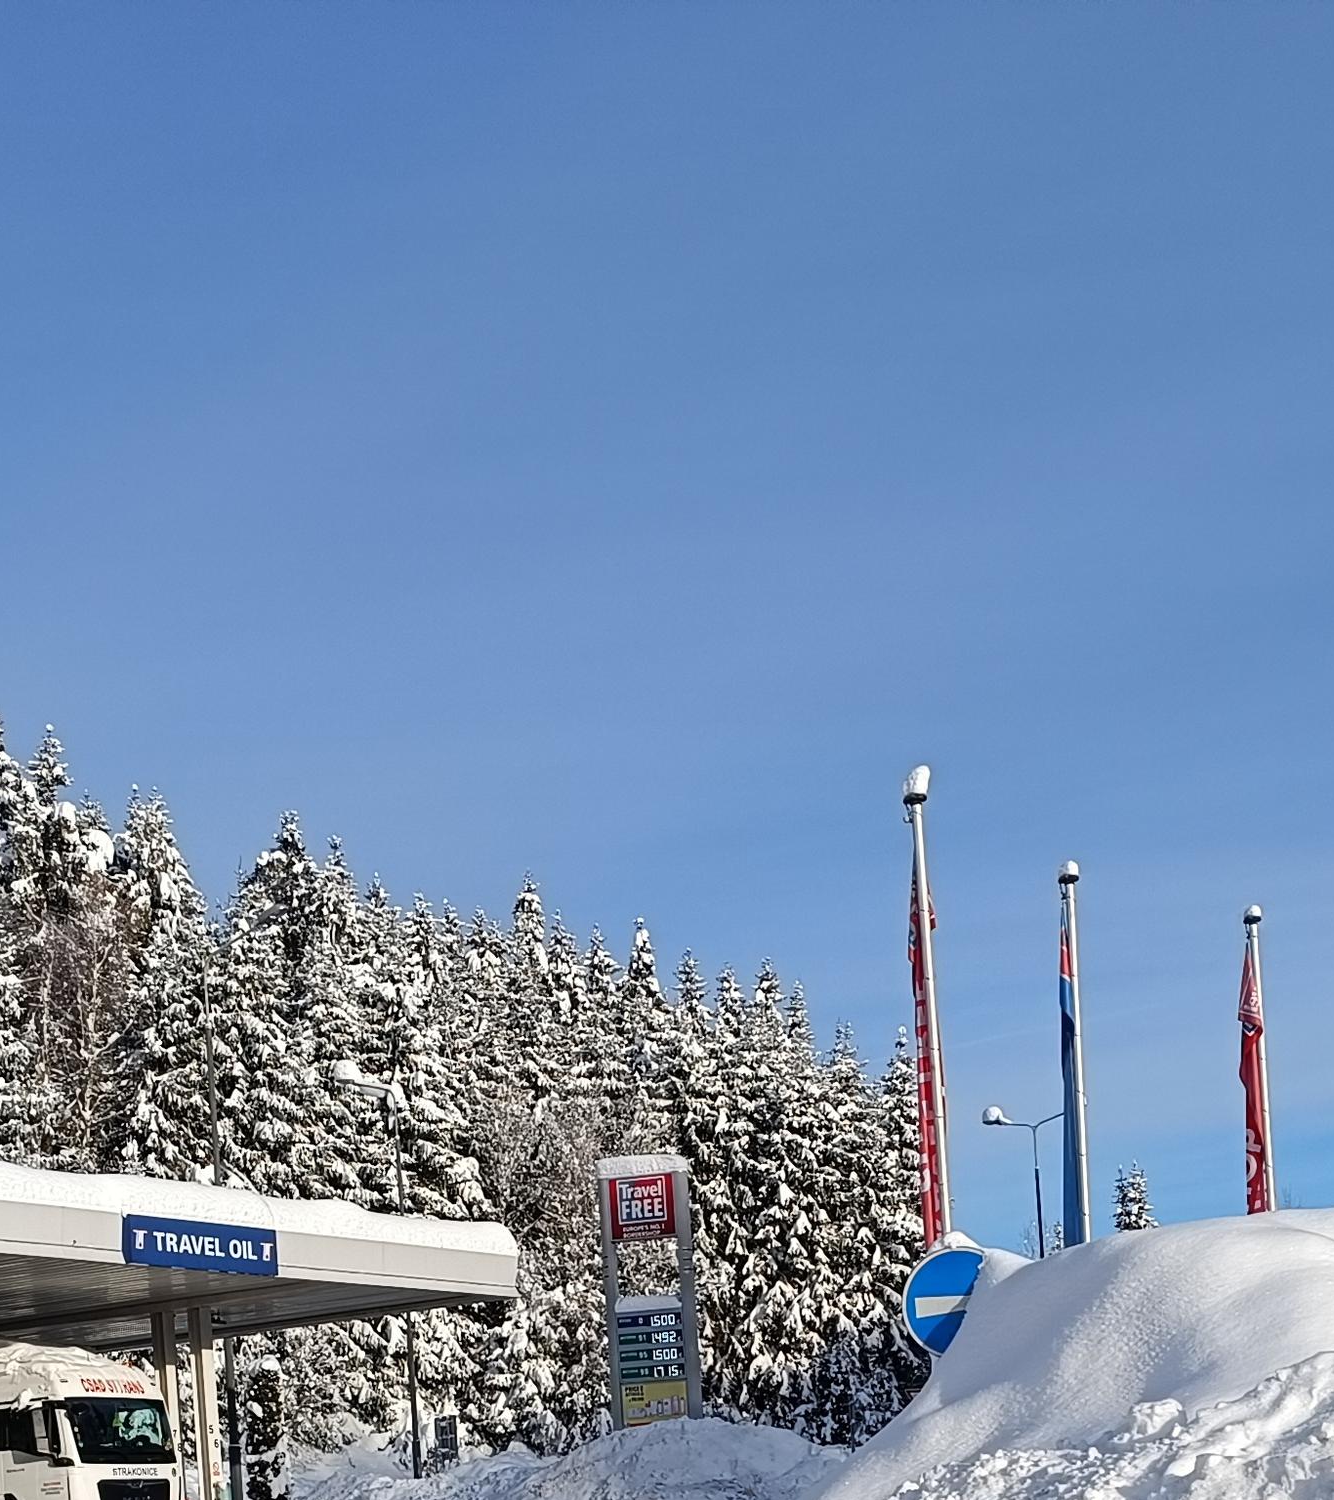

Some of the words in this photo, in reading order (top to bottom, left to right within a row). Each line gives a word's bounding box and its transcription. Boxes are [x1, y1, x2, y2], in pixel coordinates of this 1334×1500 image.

[619, 1180, 662, 1199] Travel
[621, 1198, 663, 1219] FREE
[153, 1231, 225, 1258] TRAVEL
[229, 1239, 258, 1260] OIL
[172, 1429, 177, 1438] 7
[208, 1424, 214, 1434] 5
[177, 1442, 183, 1452] 8
[214, 1438, 219, 1448] 6
[112, 1467, 159, 1476] STRAKONICE
